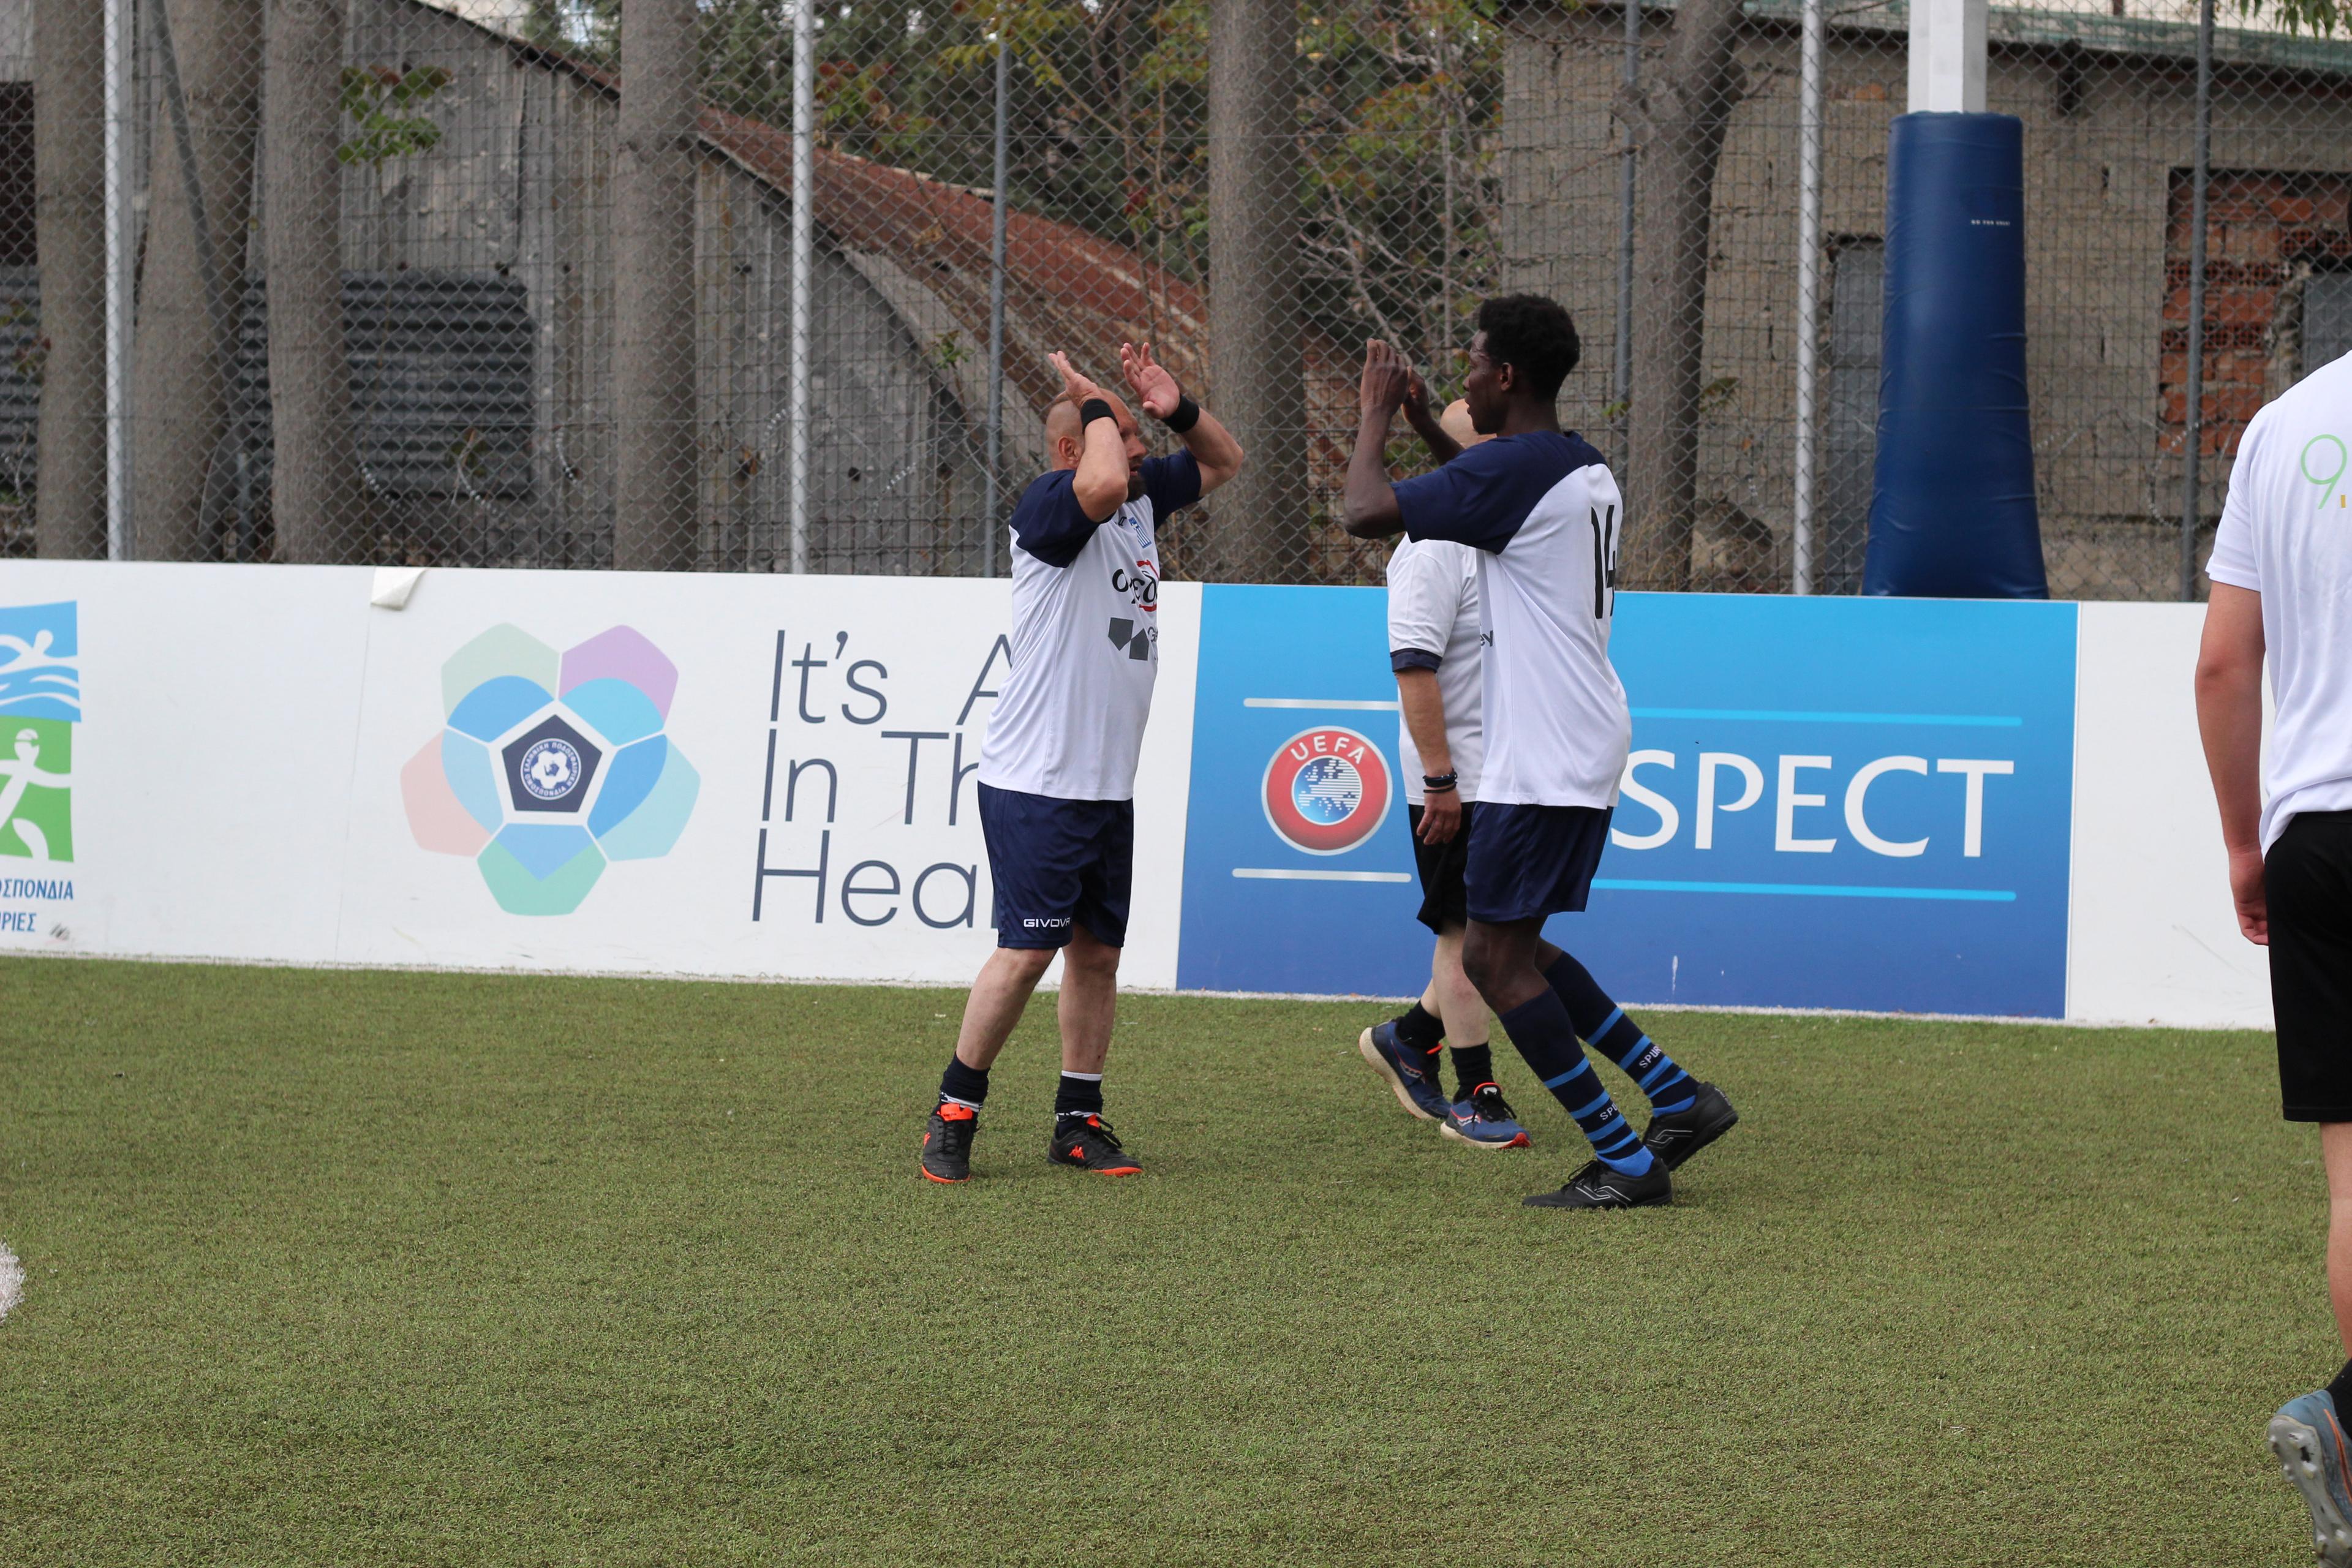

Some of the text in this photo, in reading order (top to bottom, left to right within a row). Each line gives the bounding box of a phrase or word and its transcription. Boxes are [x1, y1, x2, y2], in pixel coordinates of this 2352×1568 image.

[1591, 504, 1616, 619] 14
[770, 630, 888, 725] It's
[762, 728, 838, 823] In
[1290, 735, 1365, 764] UEFA
[1611, 748, 2015, 858] SPECT
[0, 878, 74, 900] ΣΠΟΝΔΙΑ
[752, 828, 998, 929] Hea
[1023, 917, 1070, 927] GIVOVA
